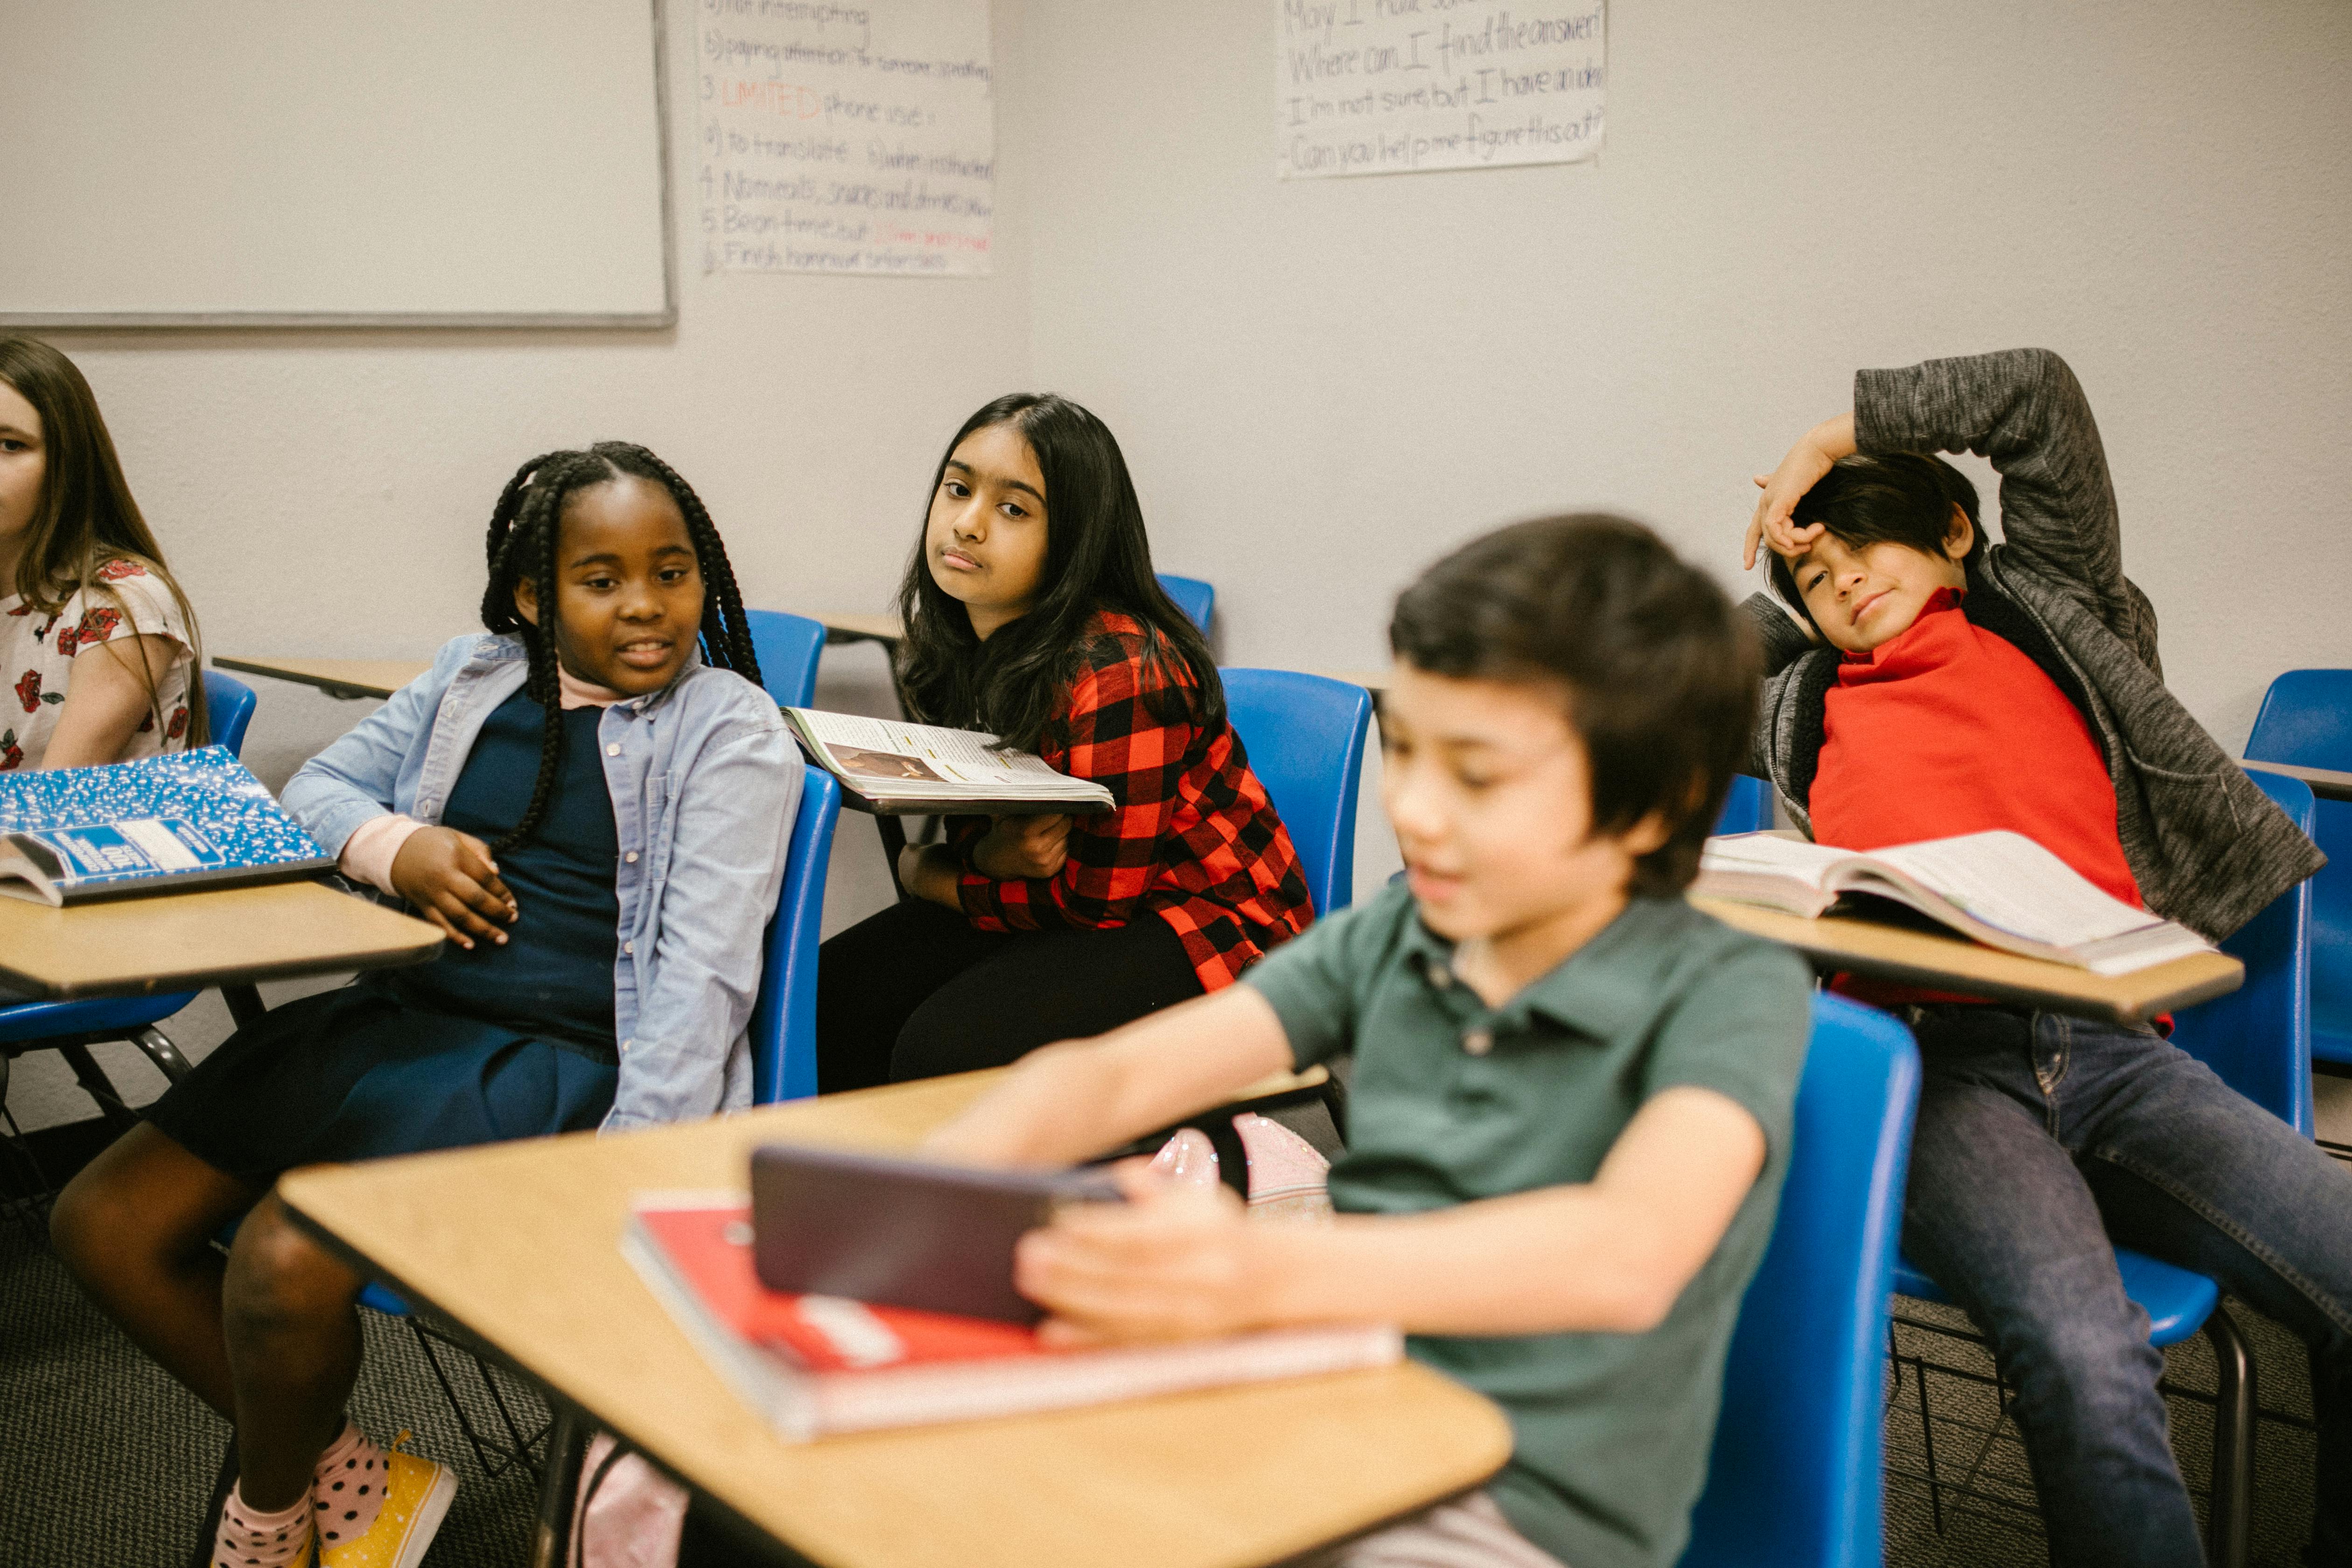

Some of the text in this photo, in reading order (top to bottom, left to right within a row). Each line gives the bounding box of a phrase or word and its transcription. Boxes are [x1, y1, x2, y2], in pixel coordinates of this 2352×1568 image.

[1289, 44, 1359, 84] Where
[1364, 46, 1400, 75] can
[1404, 30, 1429, 70] I
[1435, 16, 1494, 77] find
[1496, 11, 1525, 50] the
[1338, 88, 1374, 116] not
[1430, 83, 1468, 108] but
[1473, 68, 1497, 104] I
[1500, 66, 1552, 97] have
[1378, 131, 1429, 170] help
[1433, 133, 1461, 152] me
[1465, 111, 1524, 161] figure
[1526, 115, 1562, 144] this
[100, 846, 134, 869] 100
[120, 845, 148, 867] SHEETS
